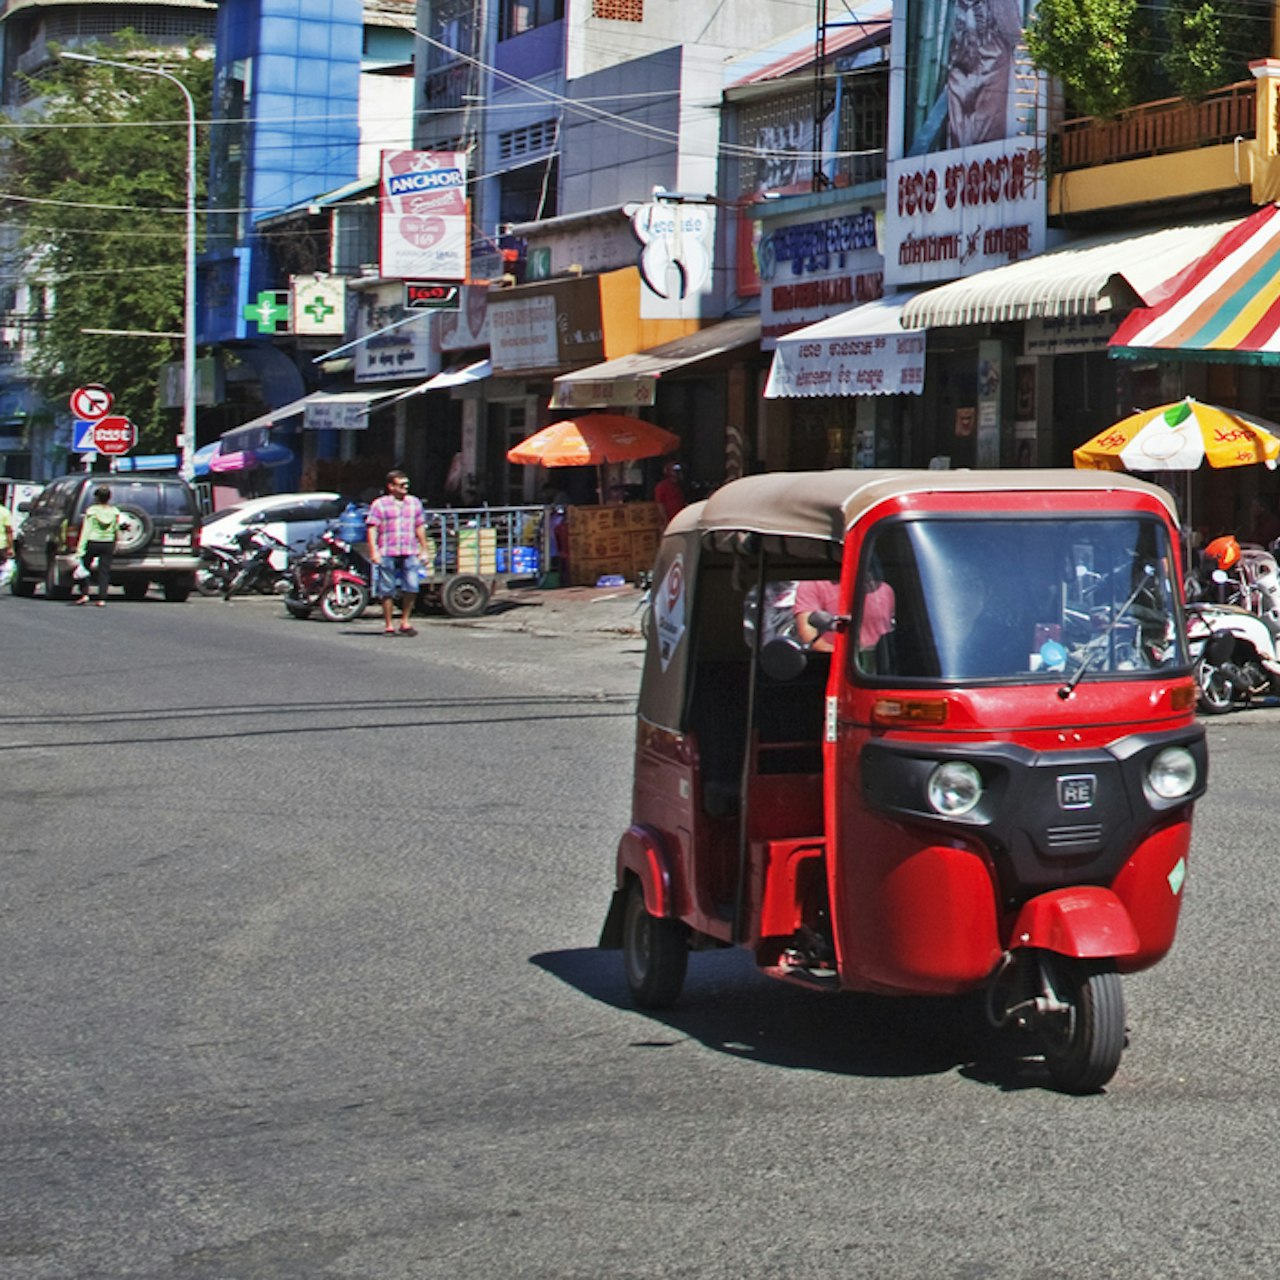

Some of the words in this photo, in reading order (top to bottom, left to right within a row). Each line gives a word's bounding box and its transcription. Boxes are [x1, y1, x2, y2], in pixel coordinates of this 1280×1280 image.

[391, 170, 464, 194] ANCHOR
[414, 233, 434, 246] 169
[1064, 786, 1089, 802] RE
